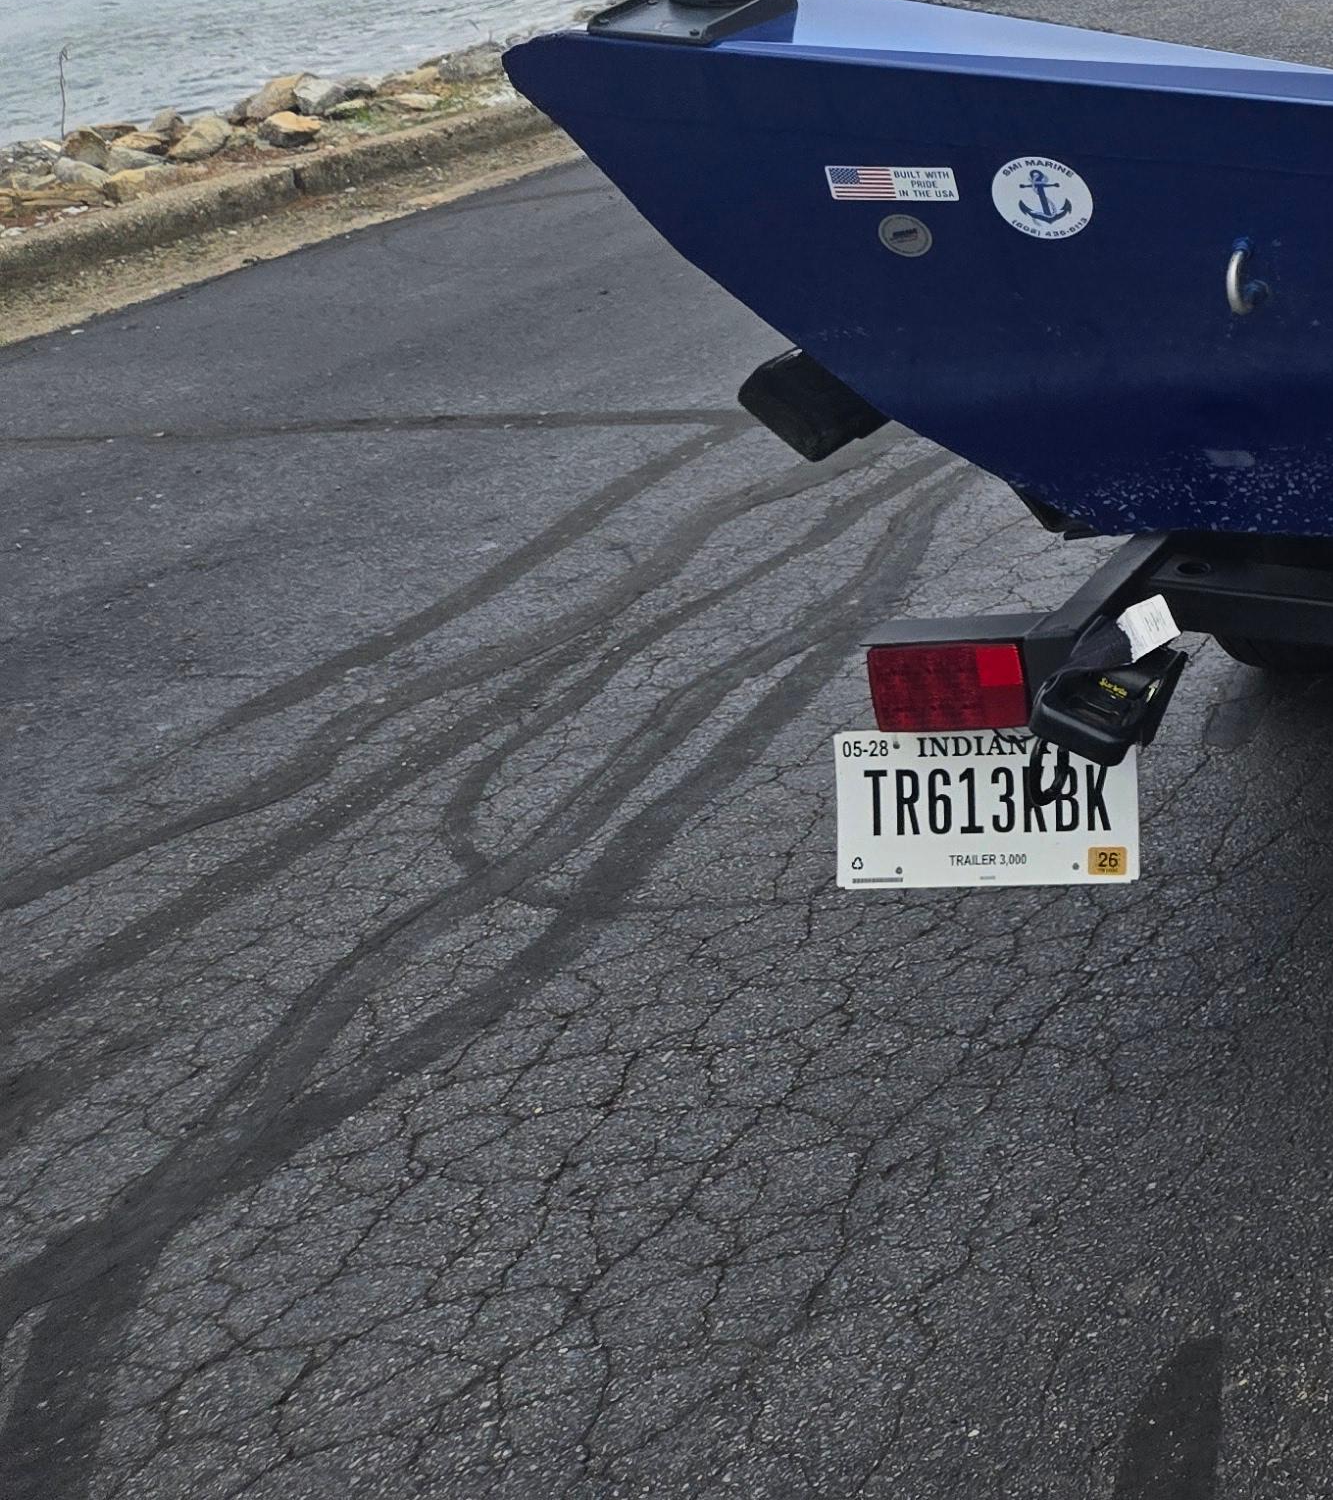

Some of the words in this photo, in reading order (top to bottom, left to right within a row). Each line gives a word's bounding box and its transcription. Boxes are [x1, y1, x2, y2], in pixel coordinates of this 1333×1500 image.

[1002, 162, 1022, 177] SMI
[1025, 159, 1074, 178] MARINE
[893, 171, 920, 179] BUILT
[925, 171, 949, 179] WITH
[911, 180, 937, 188] PRIDE
[934, 190, 955, 198] USA
[842, 740, 889, 758] 05-28
[950, 854, 997, 866] TRAILER
[999, 854, 1027, 866] 3,000
[1098, 851, 1118, 868] 26
